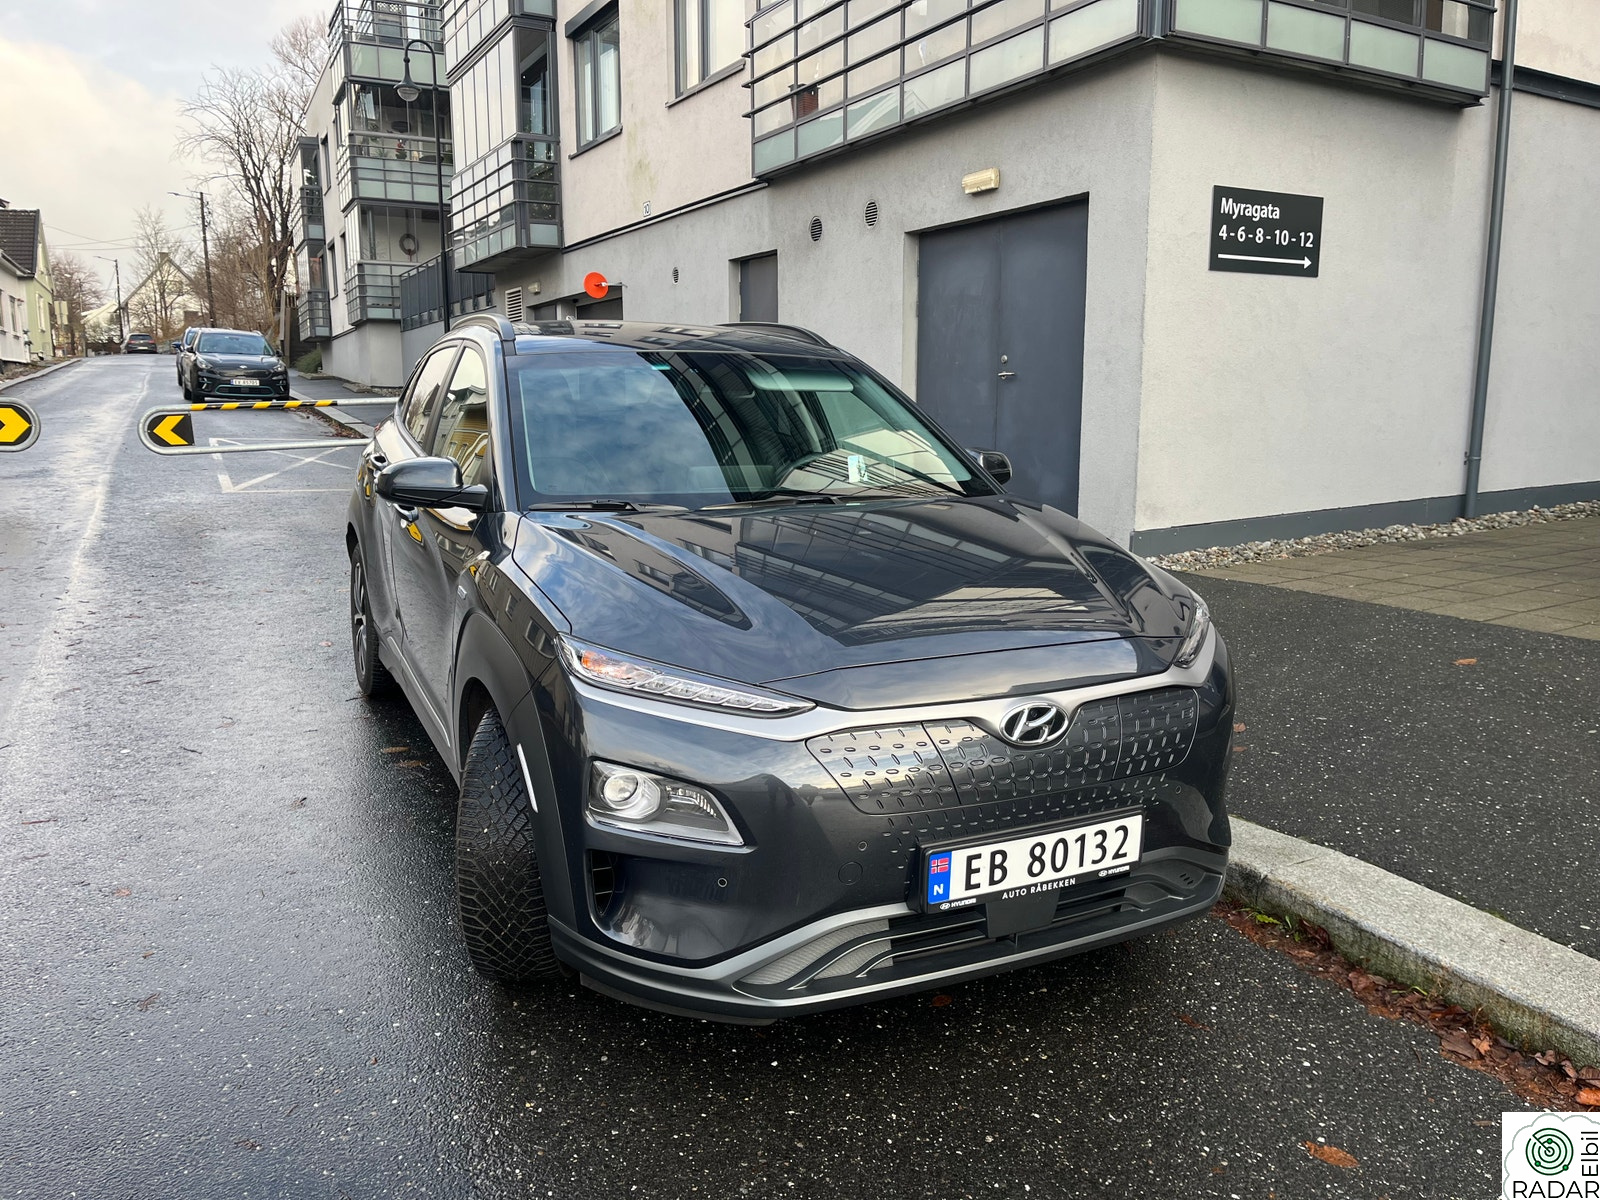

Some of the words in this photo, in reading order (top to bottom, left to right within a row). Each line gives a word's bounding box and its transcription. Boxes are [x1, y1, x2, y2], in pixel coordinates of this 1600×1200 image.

[1220, 197, 1280, 222] Myragata
[964, 849, 1008, 891] EB
[1027, 824, 1129, 878] 80132
[933, 884, 944, 896] N
[1002, 889, 1027, 900] AUTO
[1030, 877, 1076, 894] RÅBEKKEN
